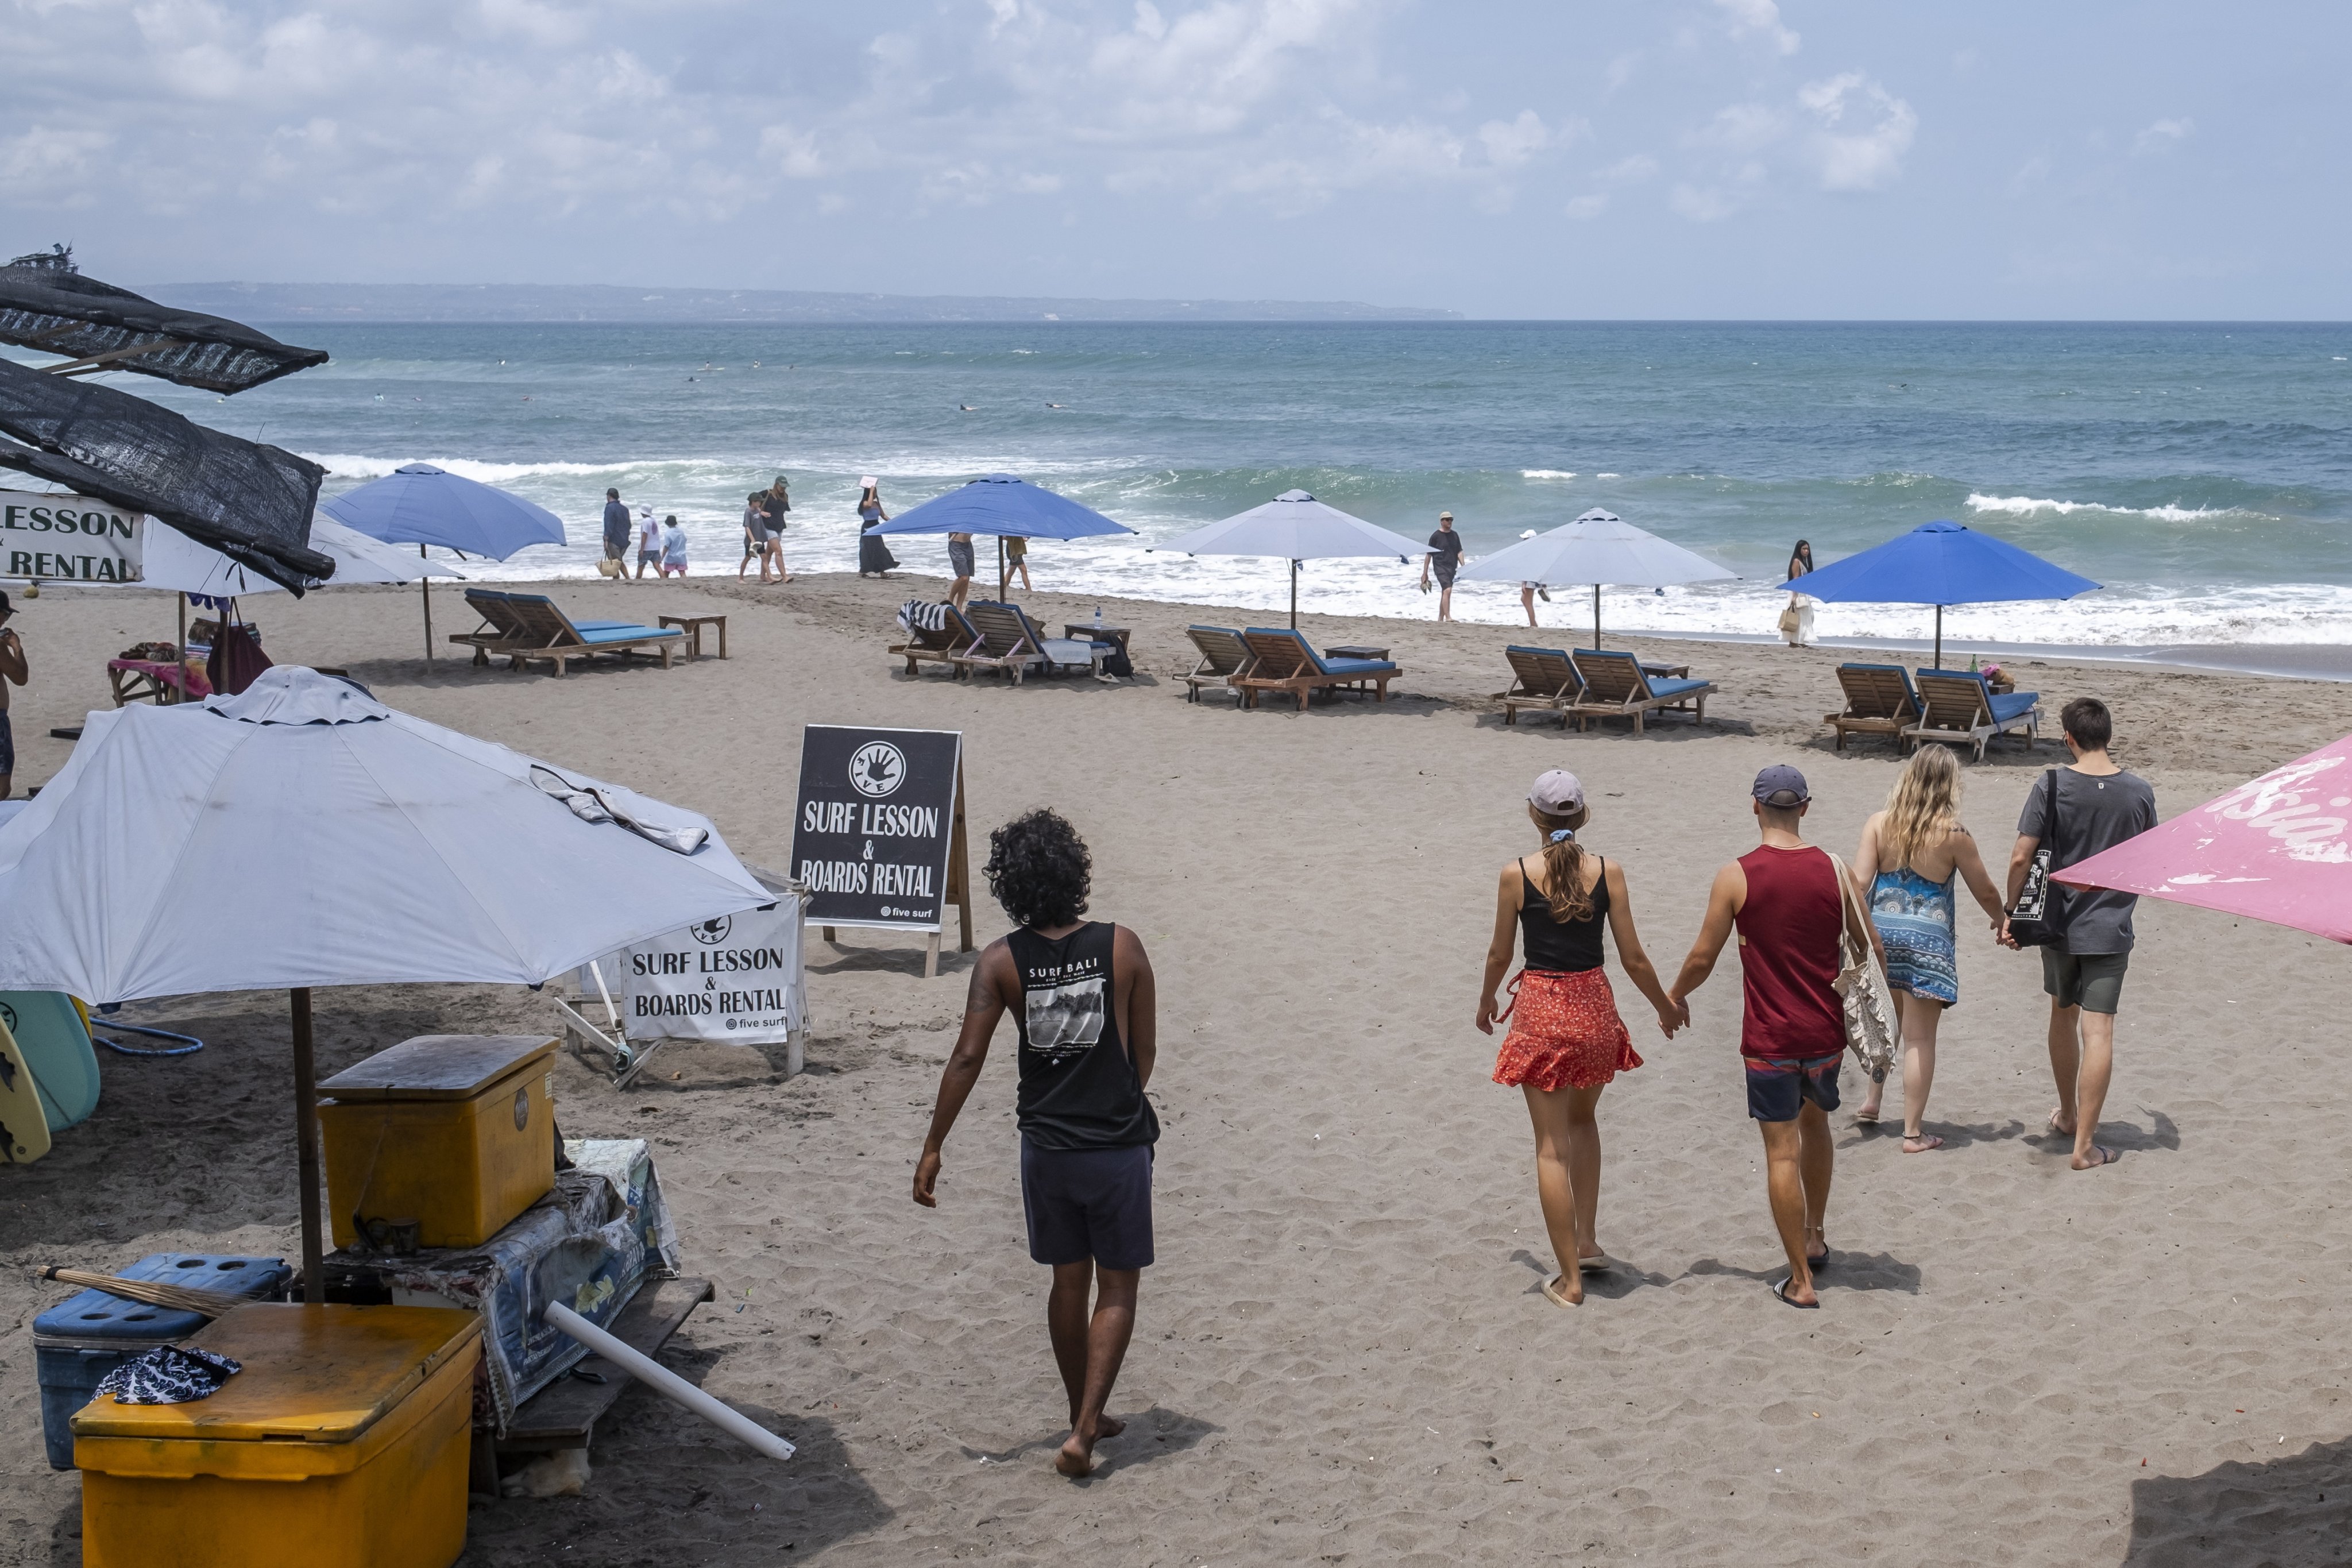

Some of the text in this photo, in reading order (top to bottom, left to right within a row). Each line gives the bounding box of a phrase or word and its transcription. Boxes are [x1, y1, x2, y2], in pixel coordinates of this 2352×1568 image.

[0, 505, 134, 538] ESSON
[804, 801, 939, 838] SURF LESSON
[863, 840, 874, 860] &
[801, 860, 934, 897] BOARDS RENTAL
[893, 907, 933, 918] five surf
[693, 926, 718, 943] IVE
[632, 952, 692, 976] SURF
[700, 948, 783, 973] LESSON
[1029, 957, 1097, 978] SURF BALI
[705, 976, 716, 991] &
[635, 988, 786, 1017] BOARDS RENTAL
[739, 1016, 786, 1029] five surf
